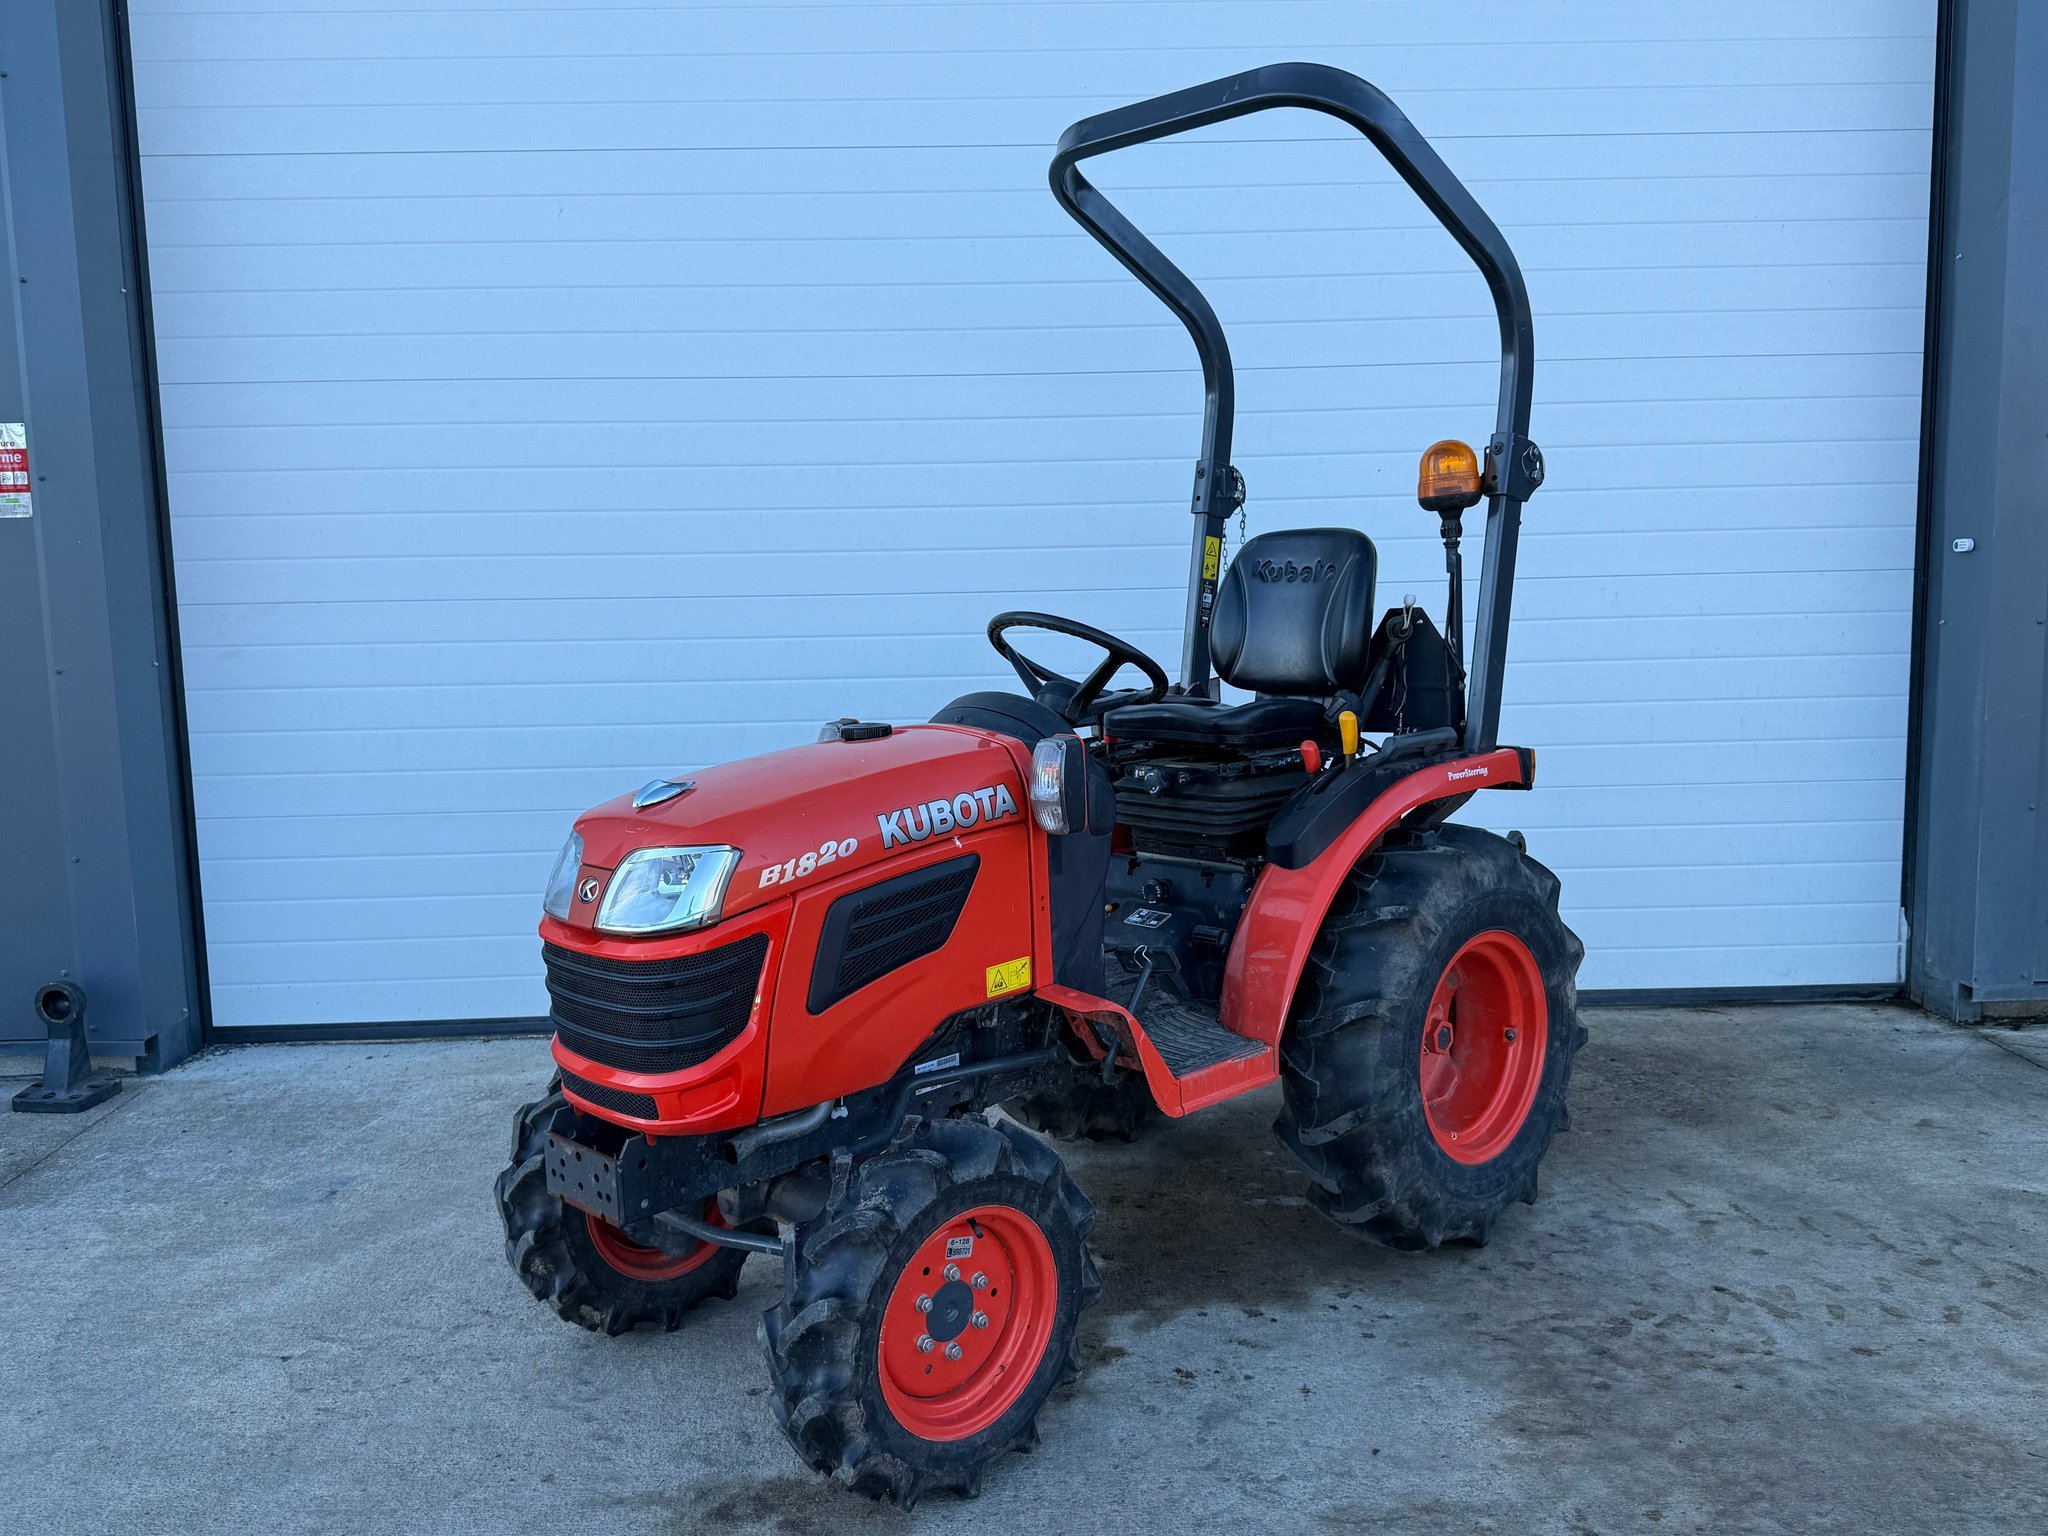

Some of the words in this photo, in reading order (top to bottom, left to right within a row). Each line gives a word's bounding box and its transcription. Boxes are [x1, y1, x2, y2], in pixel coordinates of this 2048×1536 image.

[1447, 765, 1488, 781] PowerSteering
[876, 783, 1019, 850] KUBOTA
[758, 837, 858, 889] B1820
